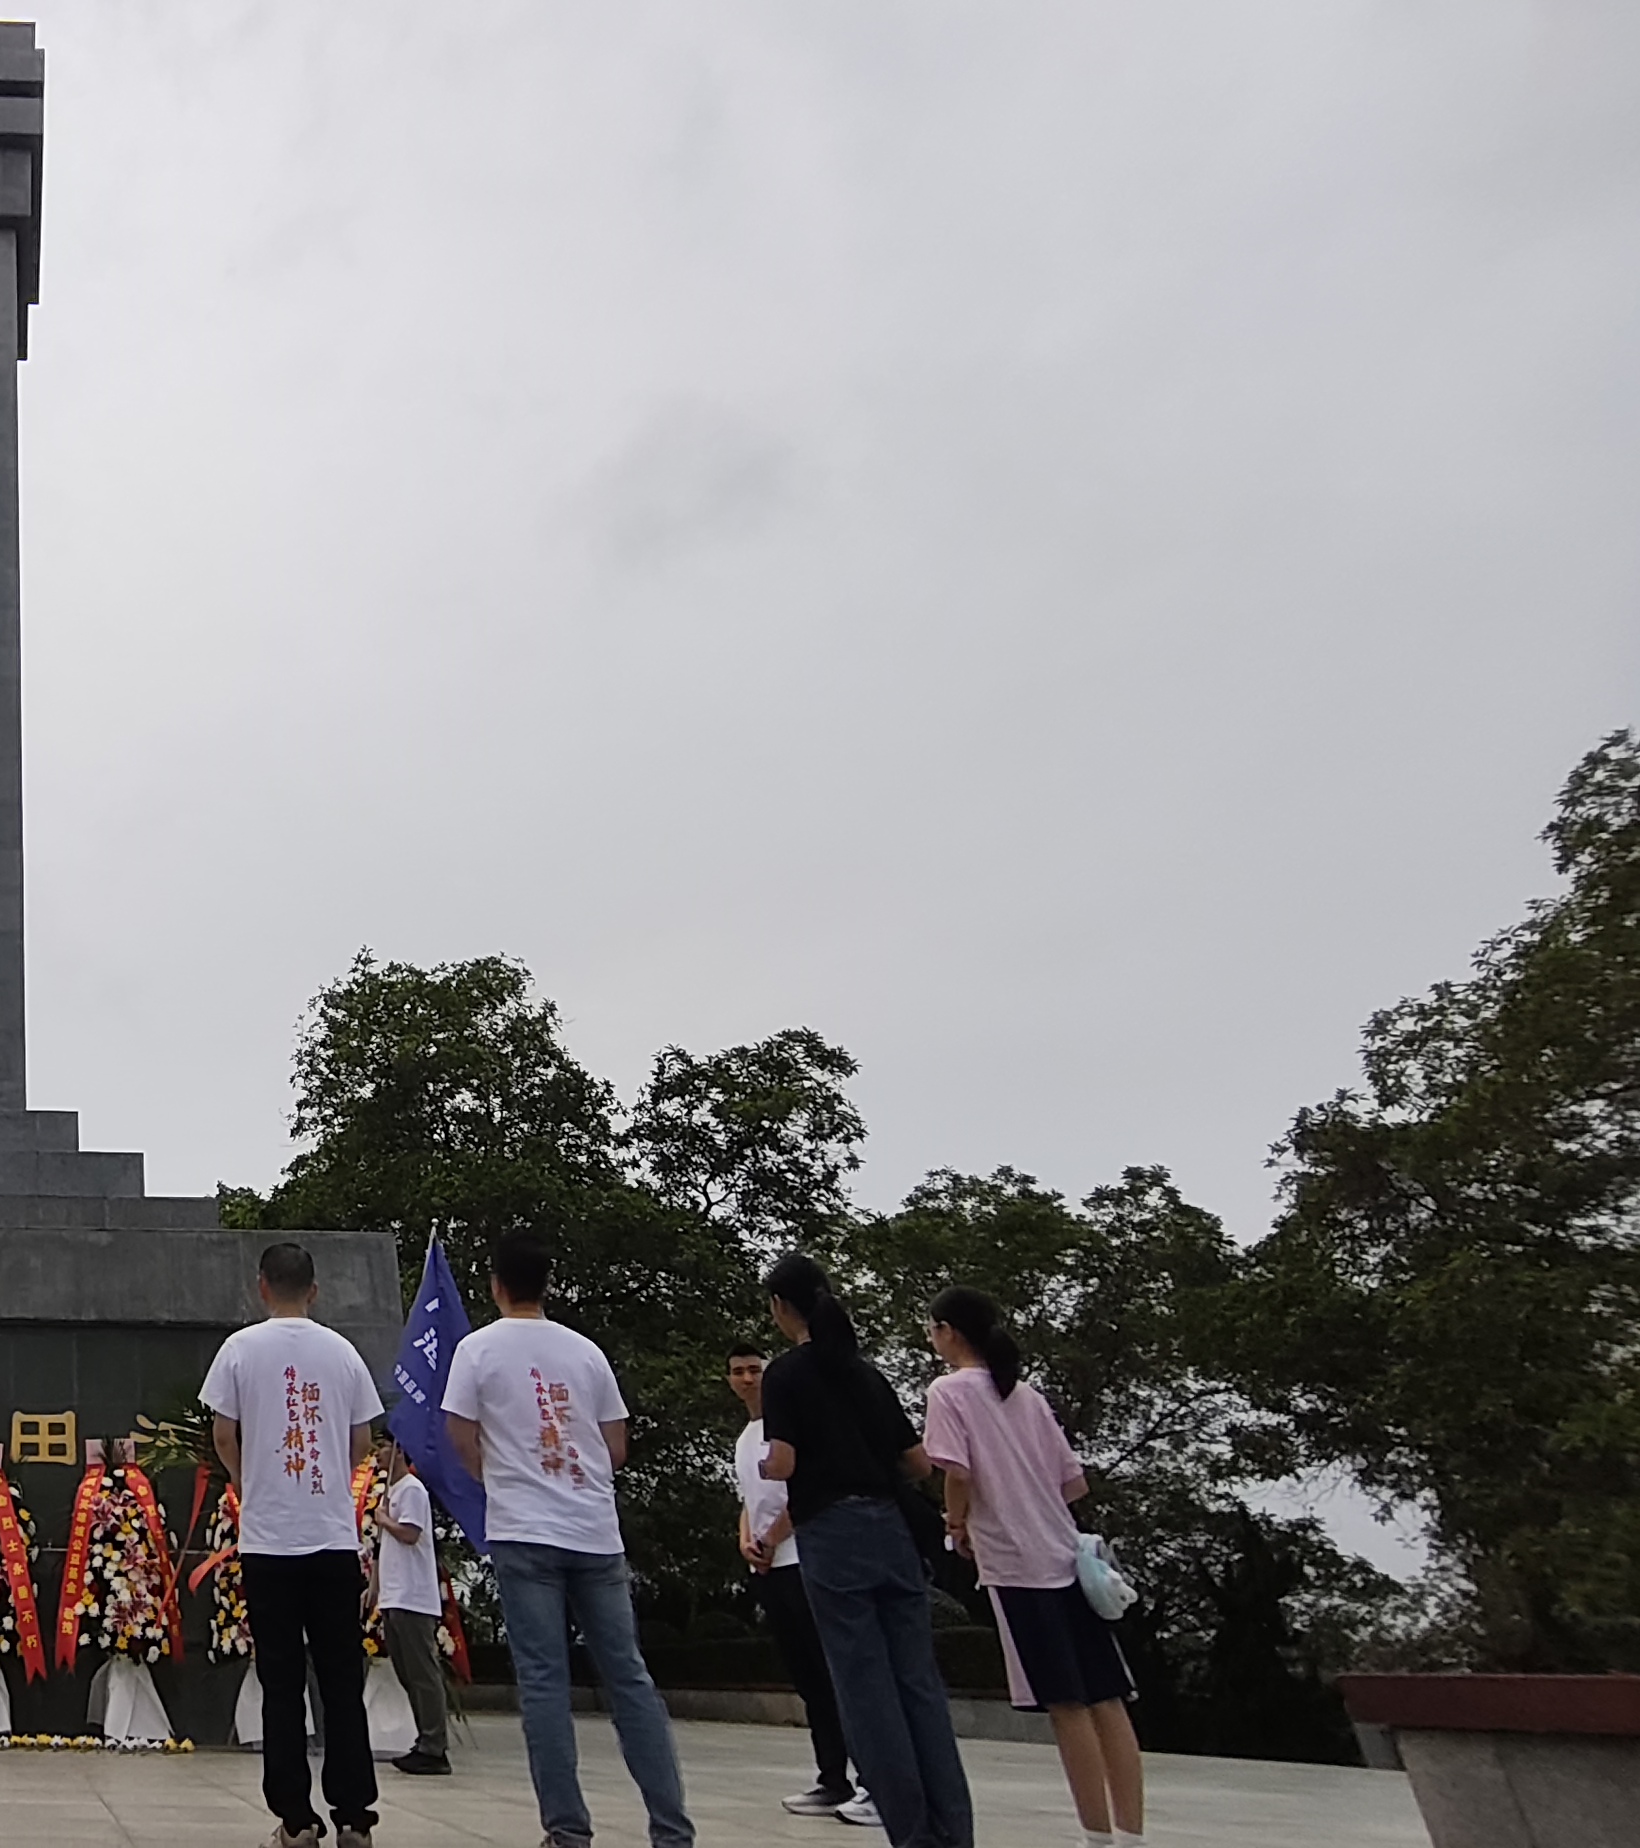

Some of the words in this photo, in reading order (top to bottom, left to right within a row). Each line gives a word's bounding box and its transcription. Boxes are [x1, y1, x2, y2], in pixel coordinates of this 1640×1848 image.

[11, 1410, 77, 1466] 田
[282, 1364, 307, 1486] 传承红色精神
[300, 1381, 325, 1495] 缅怀革命先烈
